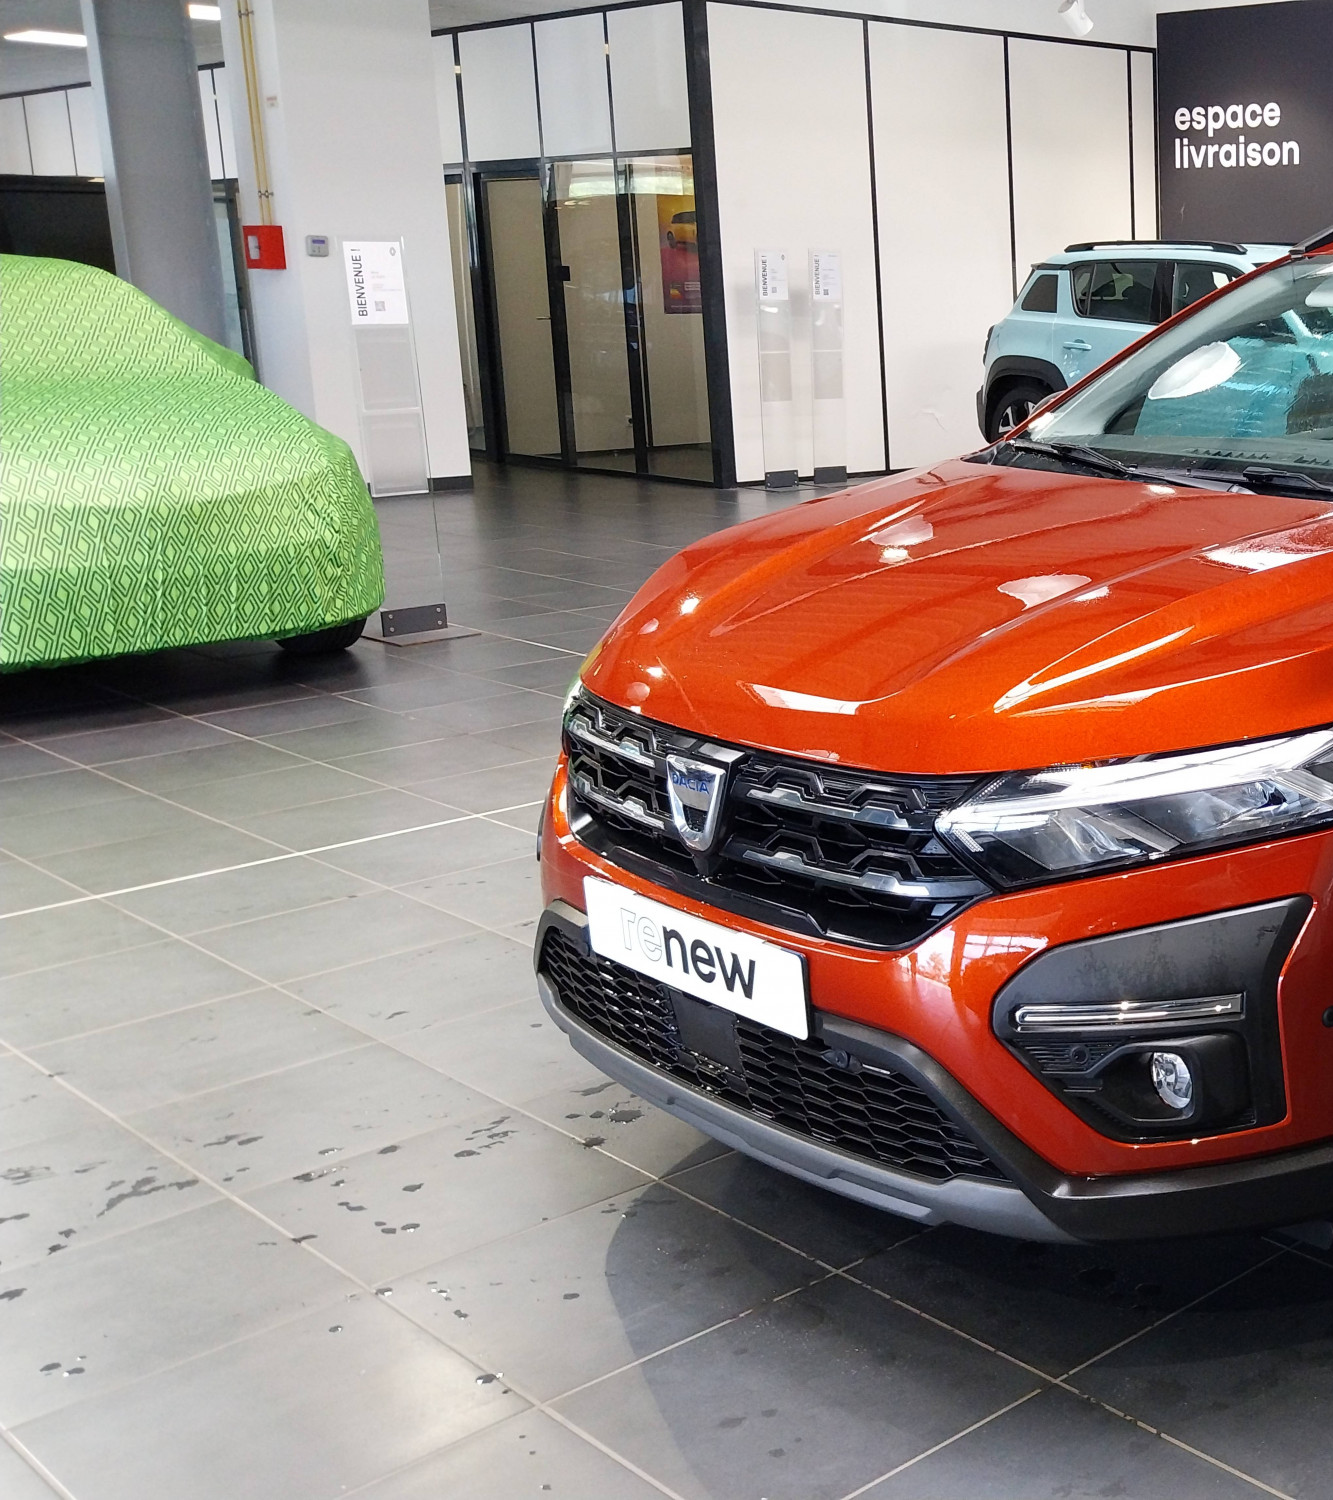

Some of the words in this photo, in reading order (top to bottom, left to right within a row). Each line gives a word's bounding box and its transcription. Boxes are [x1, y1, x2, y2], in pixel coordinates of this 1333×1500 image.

[1174, 102, 1281, 138] espace
[1174, 135, 1300, 169] livraison
[351, 254, 368, 317] BIENVENUE
[761, 259, 769, 297] BIENVENUE
[813, 258, 821, 296] BIENVENUE
[672, 772, 710, 795] DACIA
[620, 907, 756, 1001] renew
